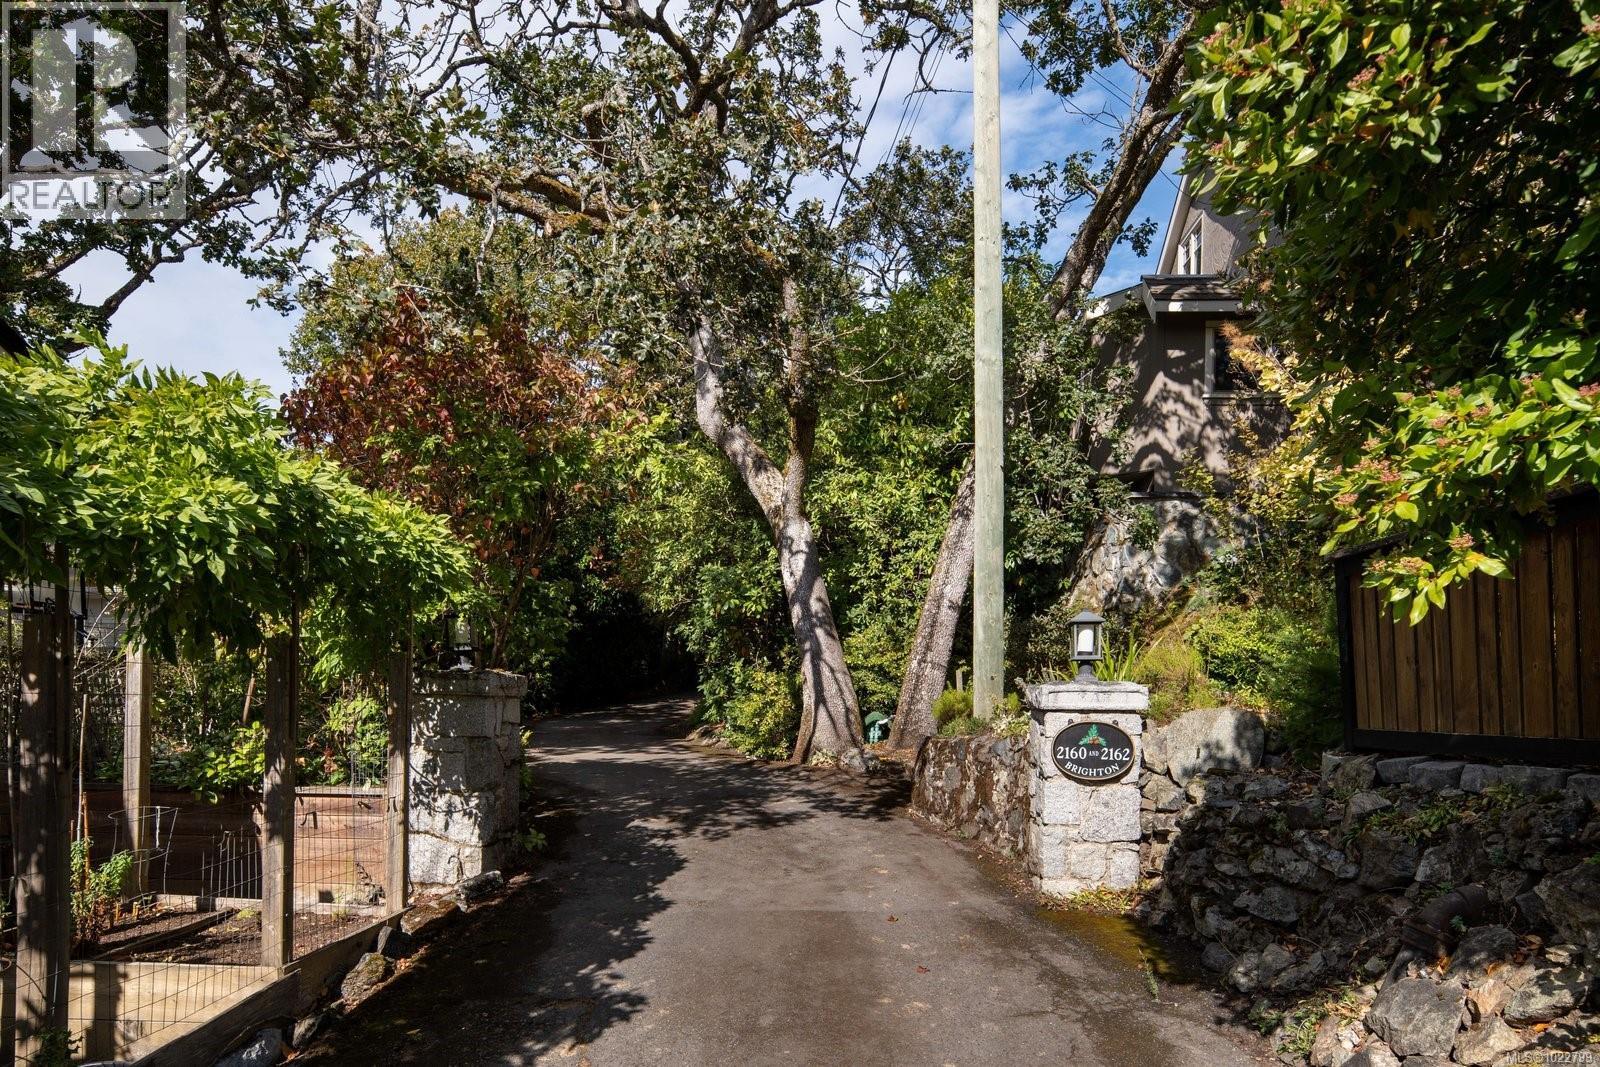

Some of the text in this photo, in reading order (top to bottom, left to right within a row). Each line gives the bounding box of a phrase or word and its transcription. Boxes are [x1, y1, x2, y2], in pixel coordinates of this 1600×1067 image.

[1056, 746, 1087, 759] 2160
[1100, 747, 1130, 761] 2162
[1064, 761, 1119, 776] BRIGHTON
